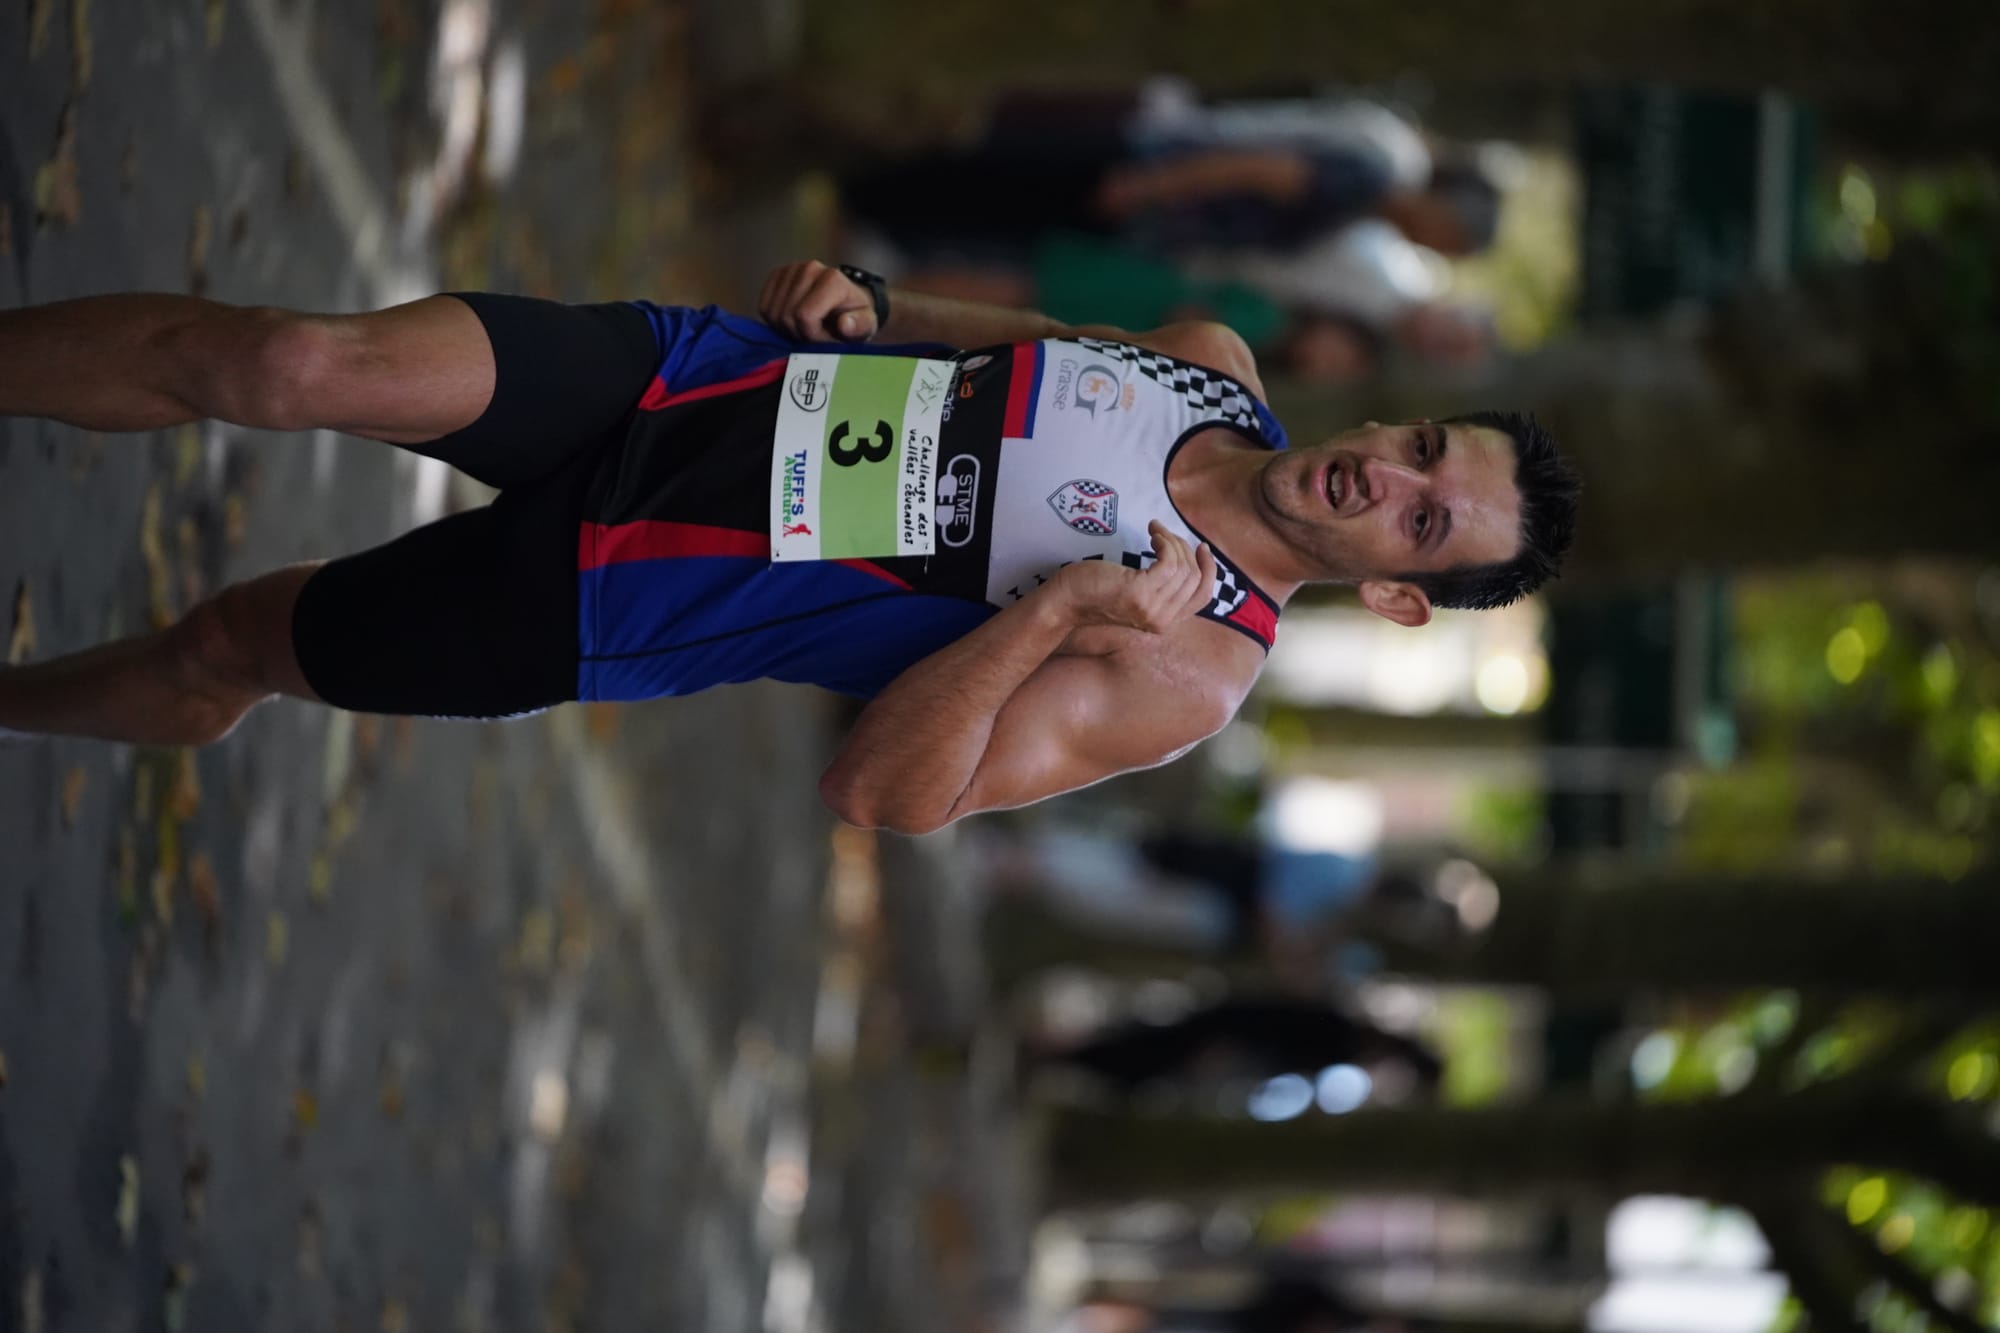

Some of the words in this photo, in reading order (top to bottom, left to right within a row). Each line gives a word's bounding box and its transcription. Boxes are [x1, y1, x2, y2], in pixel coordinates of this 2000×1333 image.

[800, 369, 819, 406] BFP
[1052, 358, 1079, 411] Grasse
[1074, 364, 1120, 419] G
[829, 419, 894, 467] 3
[906, 428, 918, 475] vallées
[915, 435, 933, 503] Challenge
[782, 455, 797, 523] Aventure
[792, 449, 807, 516] TUFF'S
[954, 474, 973, 526] STME
[904, 483, 915, 545] cévenoles
[918, 512, 929, 537] des
